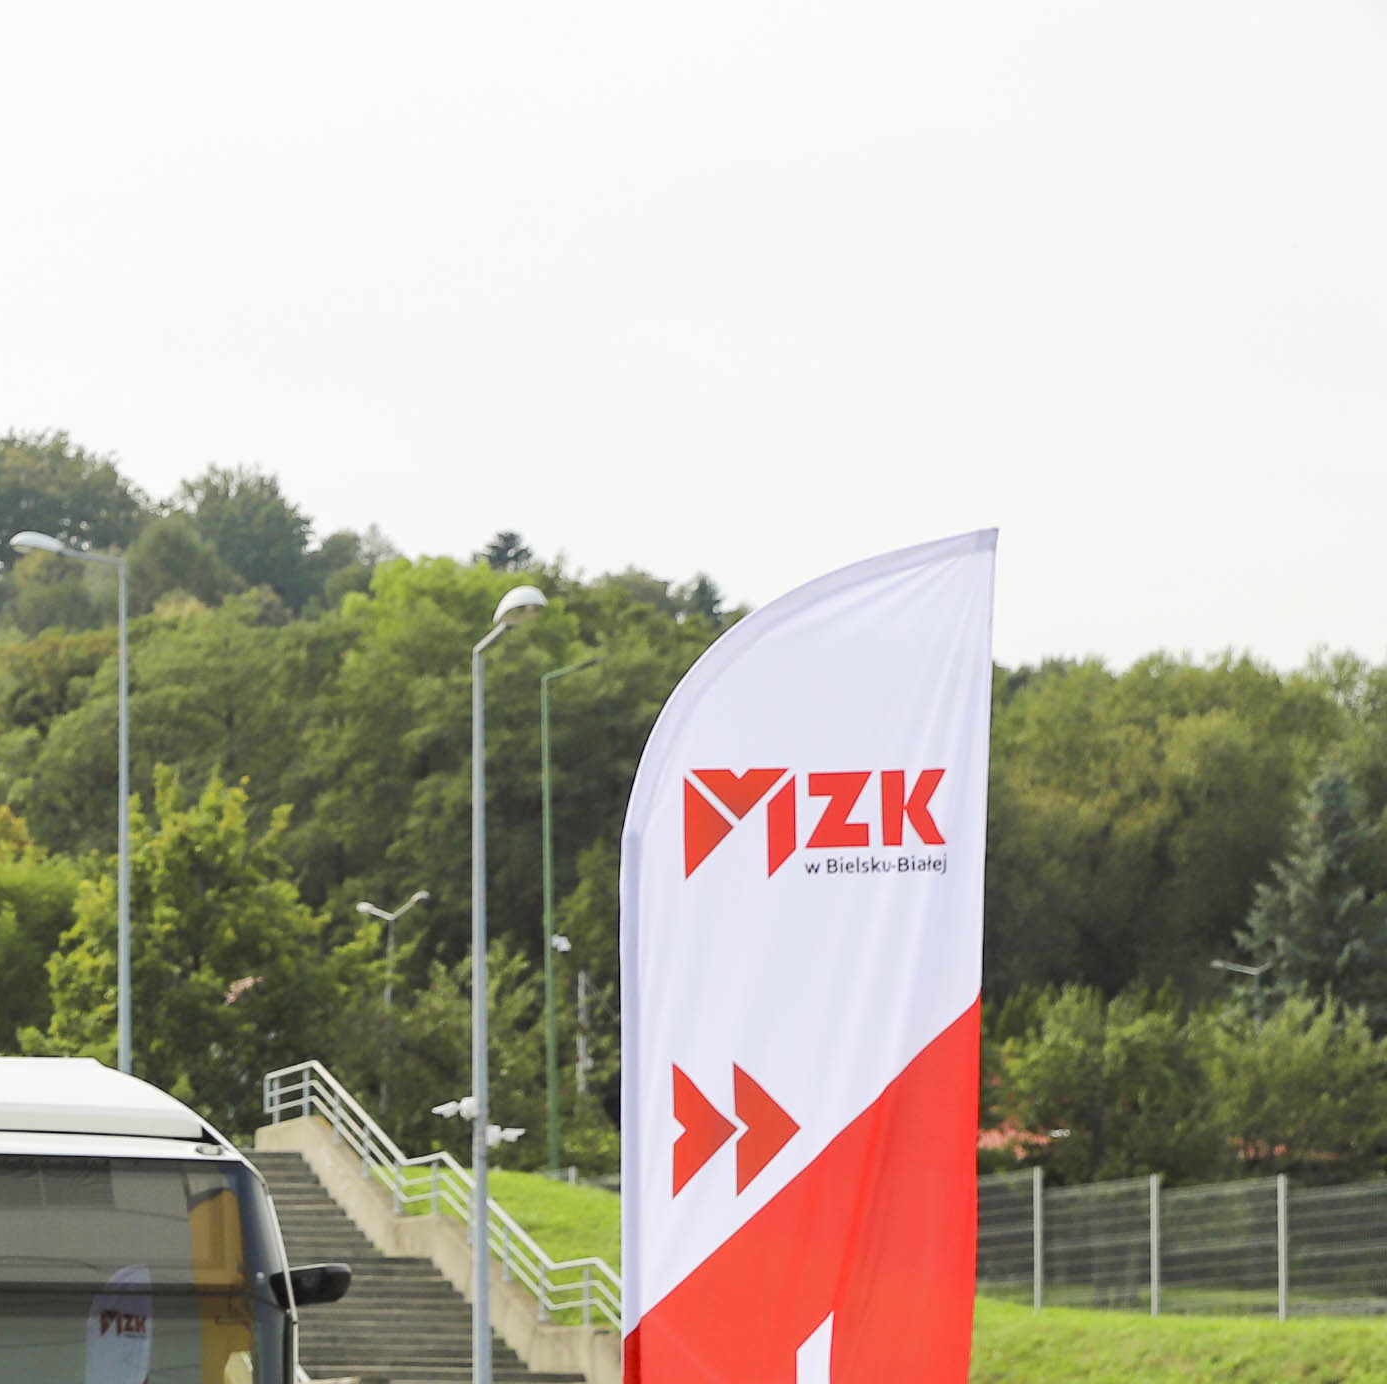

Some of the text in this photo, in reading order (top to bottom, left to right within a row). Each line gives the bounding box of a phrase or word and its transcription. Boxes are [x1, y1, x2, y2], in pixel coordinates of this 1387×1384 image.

[683, 767, 947, 880] MZK
[805, 855, 947, 876] w Bielsku-Białej
